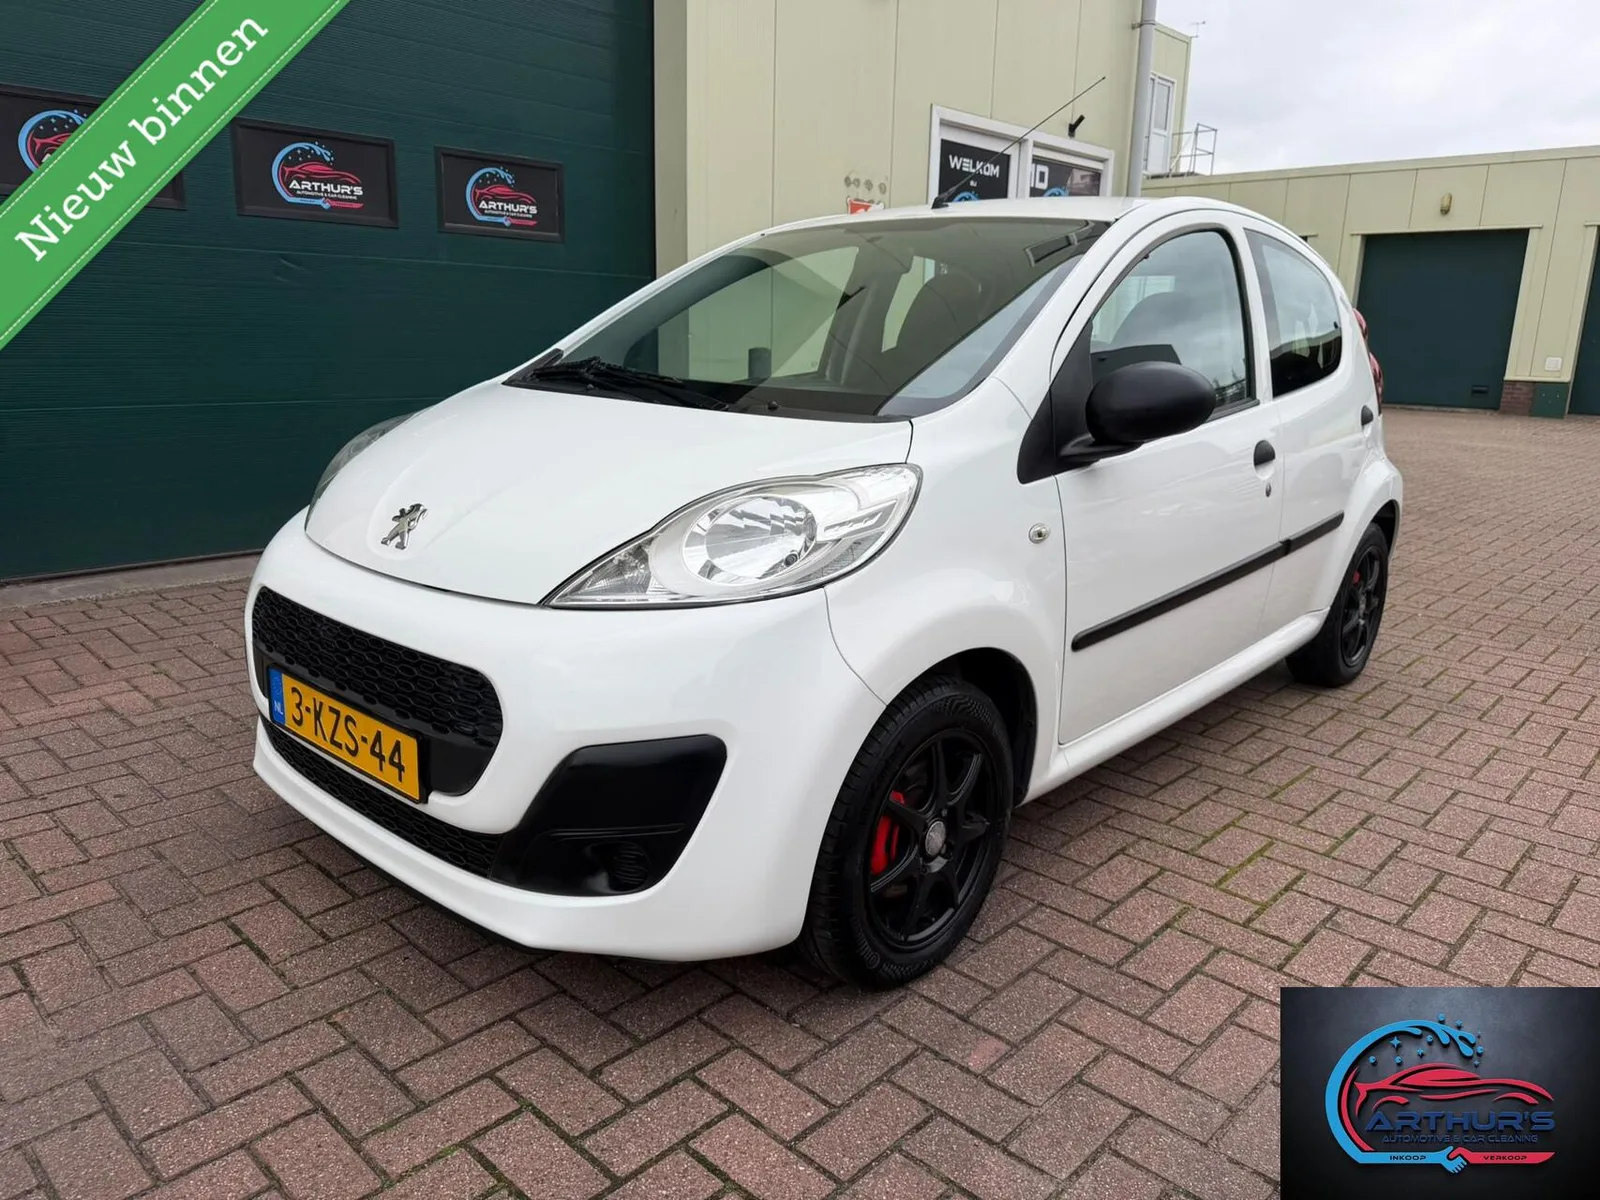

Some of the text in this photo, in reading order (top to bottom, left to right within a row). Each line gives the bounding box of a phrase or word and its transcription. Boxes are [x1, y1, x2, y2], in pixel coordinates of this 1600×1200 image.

[948, 154, 1000, 178] WELKOM
[289, 180, 363, 196] ARTHUR'S
[478, 200, 538, 215] ARTHUR'S
[273, 701, 284, 715] NL
[291, 686, 406, 783] 3-KZS-44
